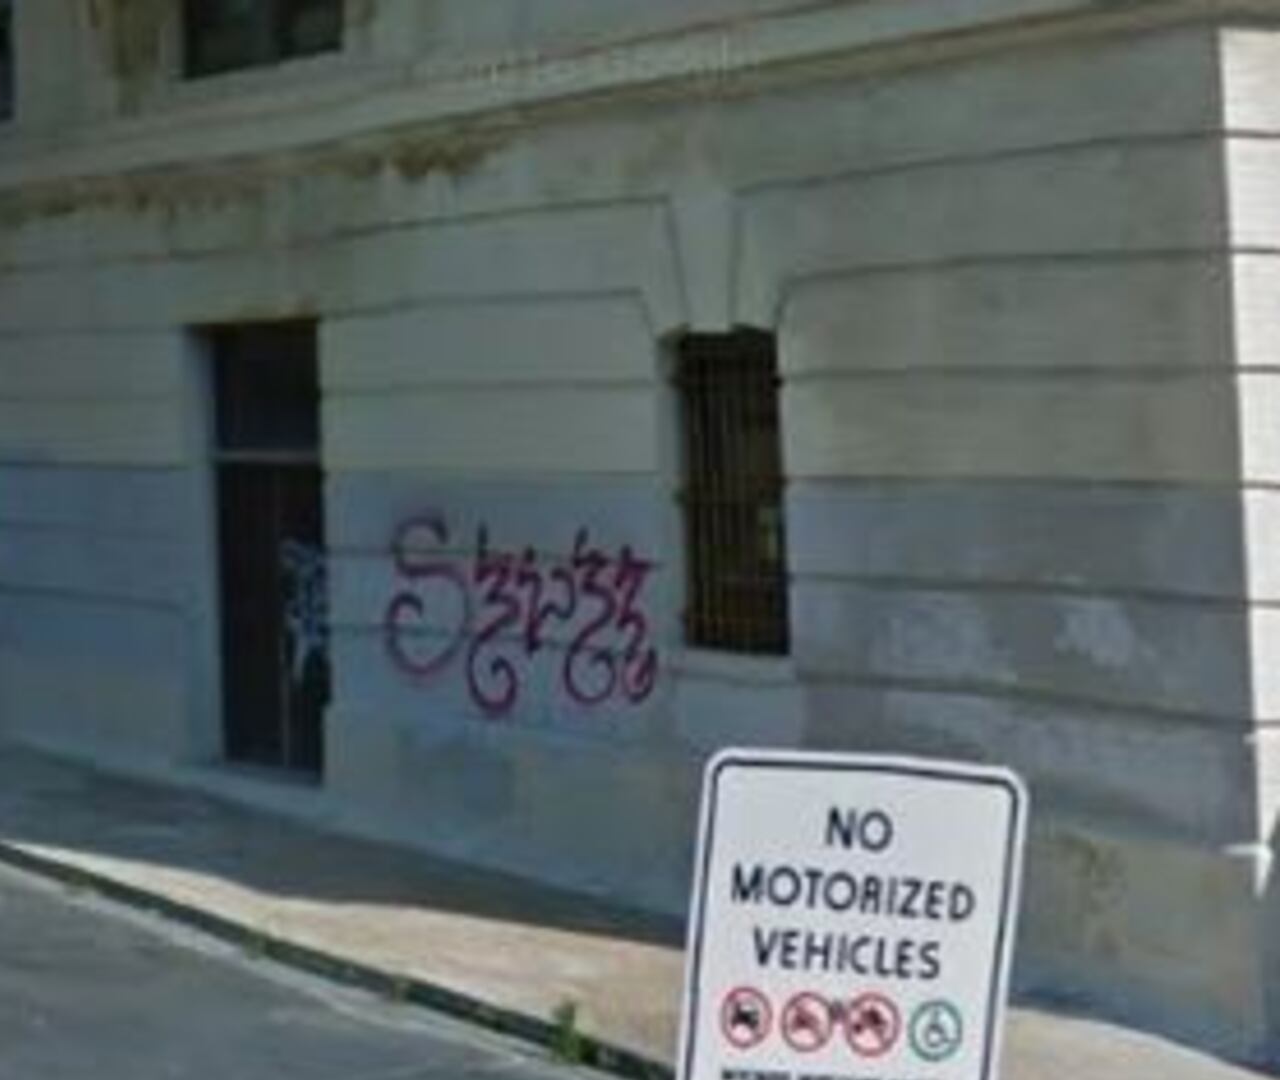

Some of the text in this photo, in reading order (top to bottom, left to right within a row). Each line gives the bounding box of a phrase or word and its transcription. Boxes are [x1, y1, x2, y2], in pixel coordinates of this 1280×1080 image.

[826, 806, 894, 853] NO
[731, 863, 977, 922] MOTORIZED
[753, 926, 941, 980] VEHICLES
